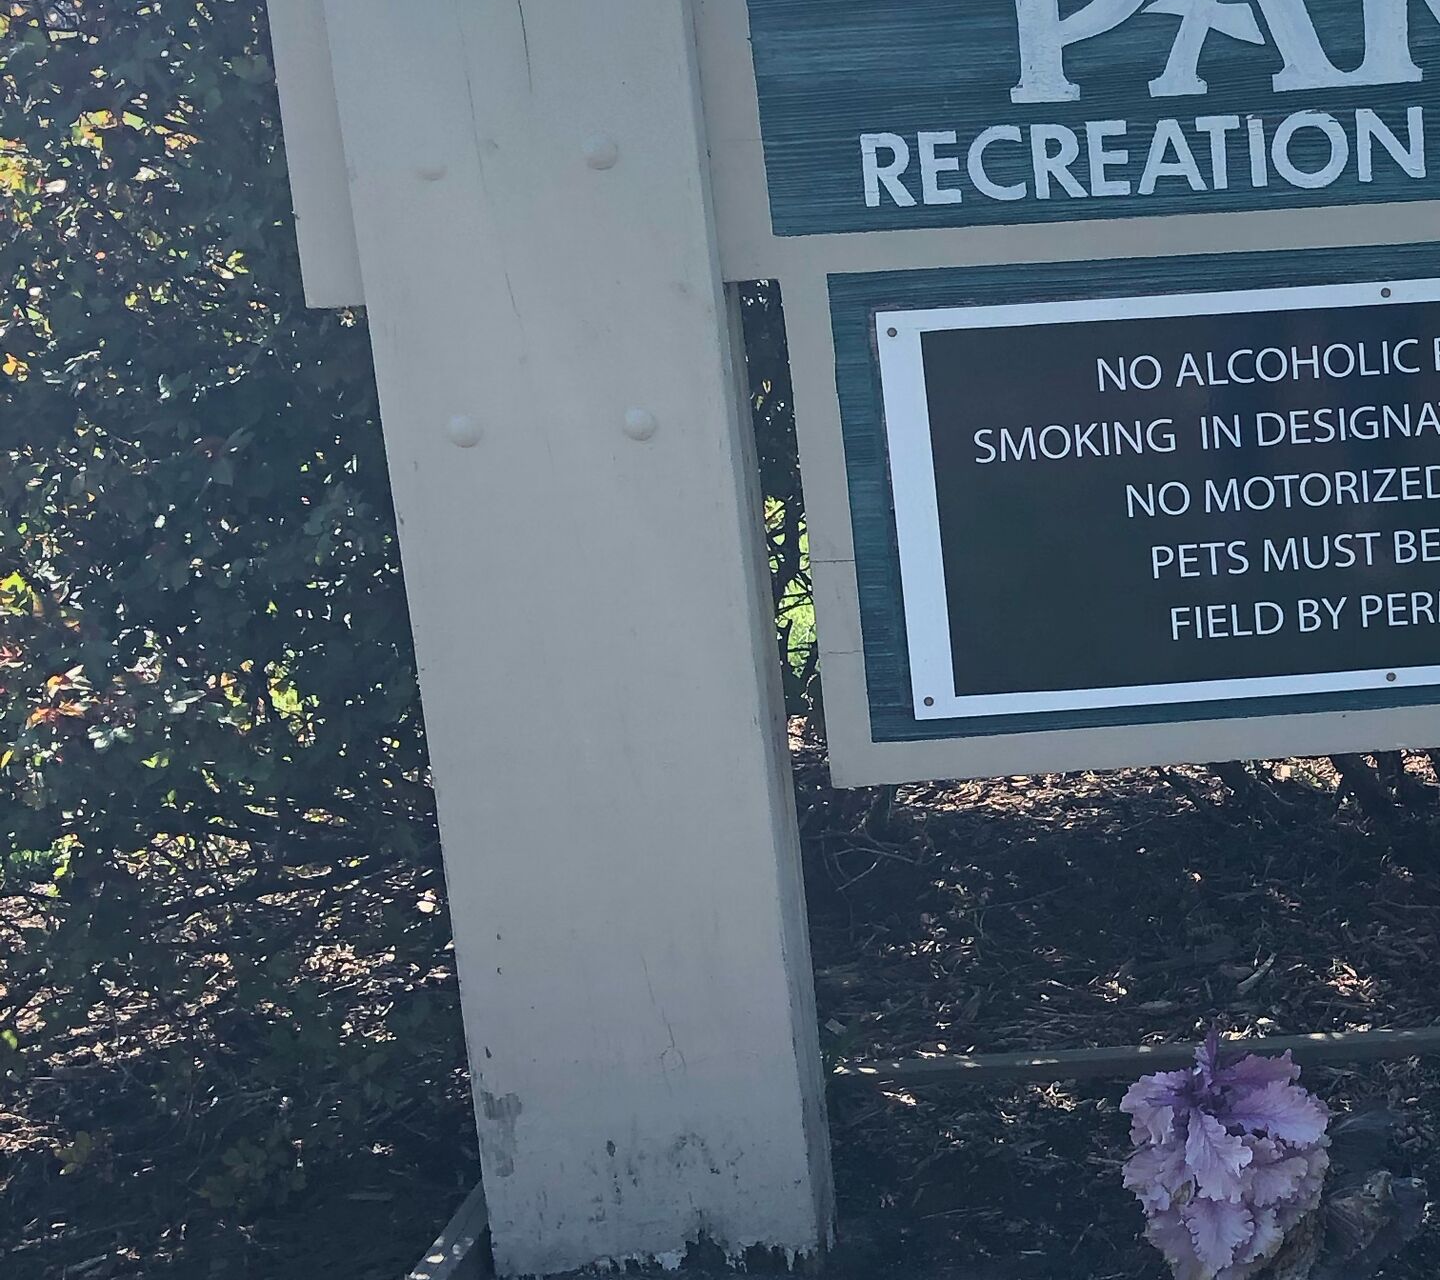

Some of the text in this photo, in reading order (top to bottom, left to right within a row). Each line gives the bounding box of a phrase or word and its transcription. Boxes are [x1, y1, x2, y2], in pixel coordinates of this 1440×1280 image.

[860, 107, 1426, 207] RECREATION
[1097, 356, 1161, 391] NO
[1176, 339, 1420, 387] ALCOHOLIC
[974, 419, 1175, 463] SMOKING
[1201, 415, 1241, 449] IN
[1127, 482, 1190, 517] NO
[1152, 541, 1248, 578] PETS
[1265, 533, 1380, 571] MUST
[1171, 602, 1283, 640] FIELD
[1298, 597, 1347, 631] BY
